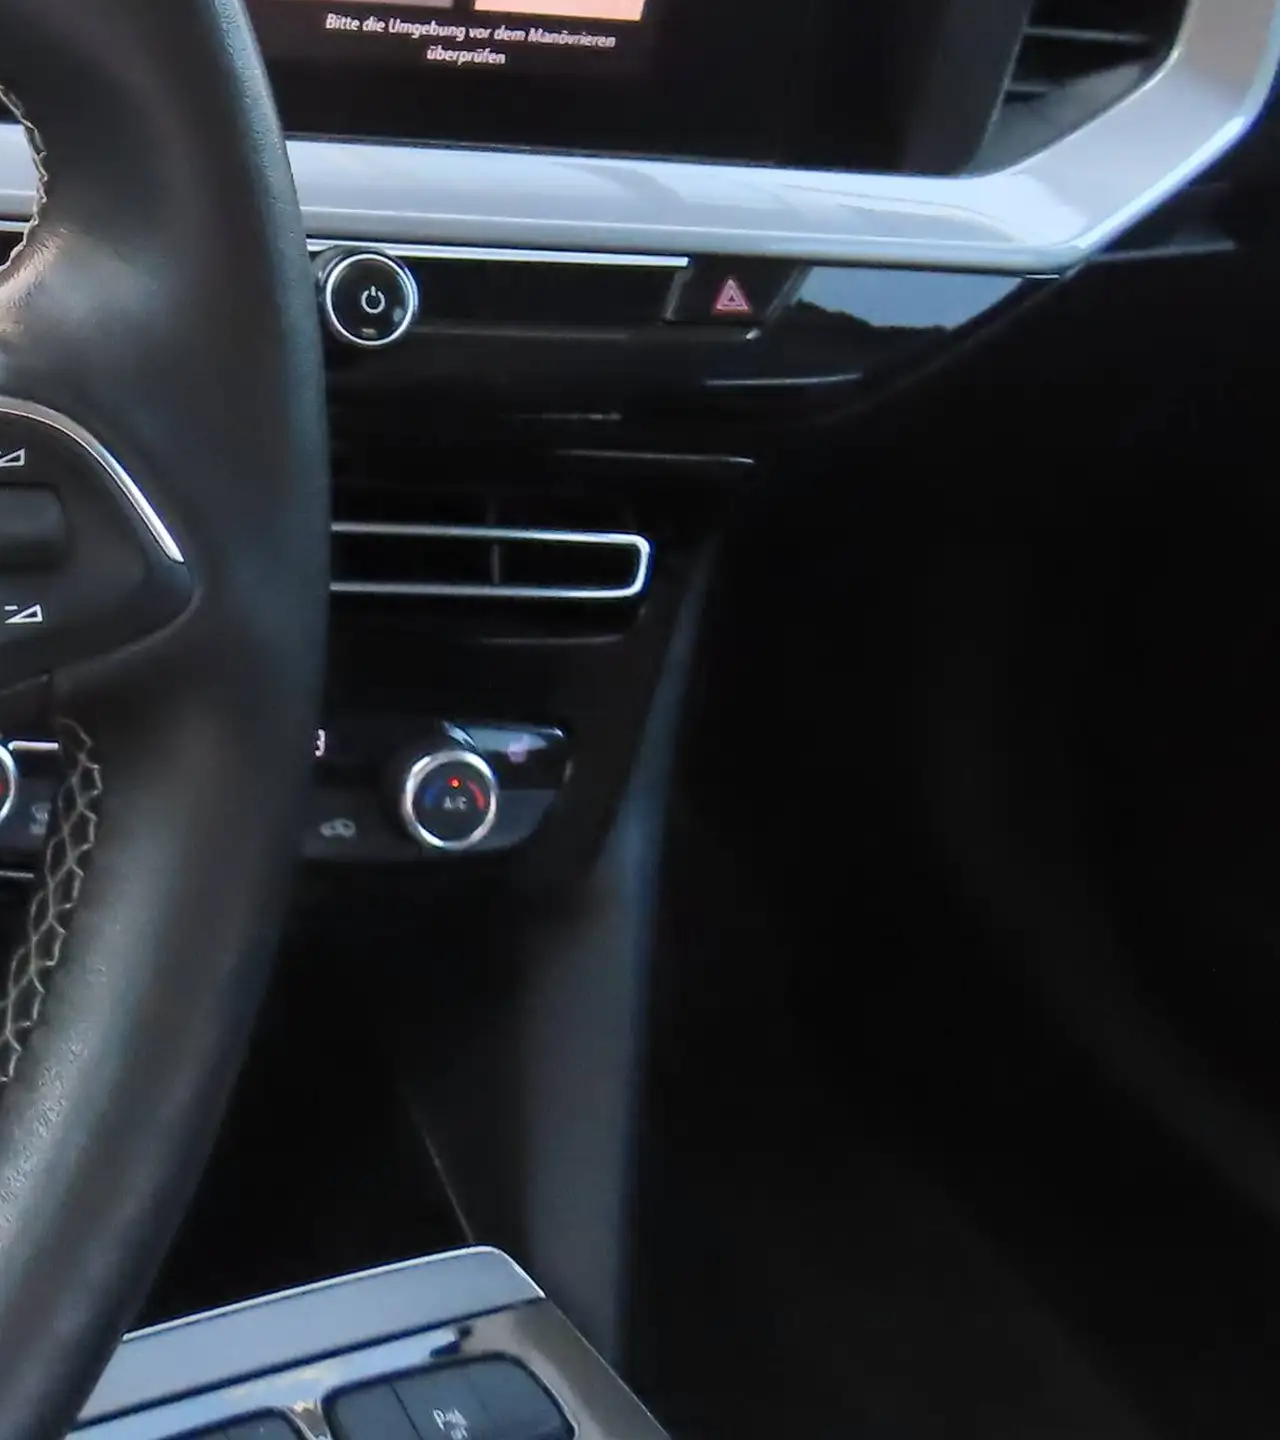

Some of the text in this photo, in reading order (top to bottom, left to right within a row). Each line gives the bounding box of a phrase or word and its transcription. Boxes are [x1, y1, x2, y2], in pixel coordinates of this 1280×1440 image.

[325, 13, 359, 31] Bitte
[362, 16, 385, 32] die
[389, 17, 466, 42] Umgebung
[468, 26, 491, 39] vor
[493, 25, 525, 42] dem
[426, 44, 506, 66] überprüfen
